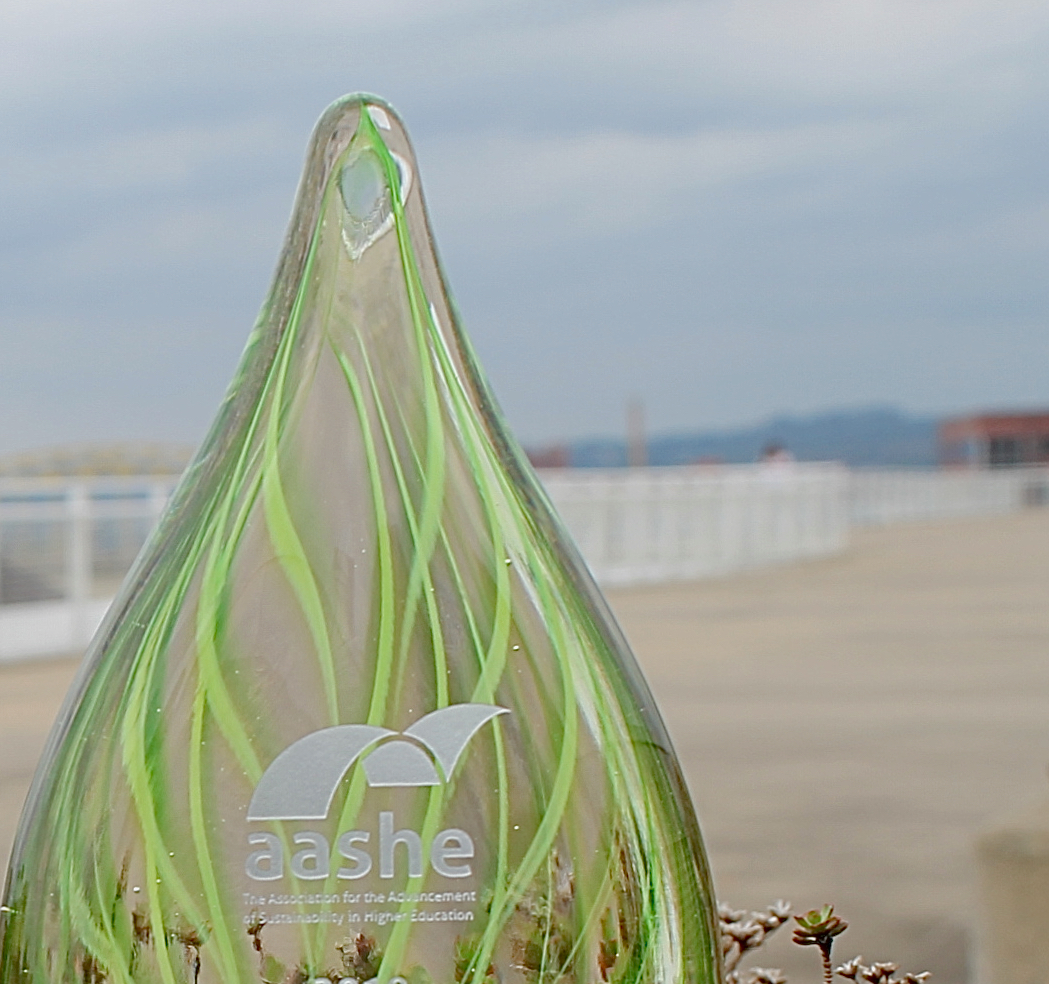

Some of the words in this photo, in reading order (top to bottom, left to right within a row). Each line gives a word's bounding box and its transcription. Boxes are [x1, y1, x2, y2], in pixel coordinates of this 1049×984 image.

[245, 811, 474, 880] aashe
[242, 892, 266, 905] The
[268, 892, 340, 905] Association
[343, 890, 361, 903] for
[364, 891, 386, 903] the
[387, 890, 477, 902] Advancement
[242, 911, 256, 924] of
[258, 910, 344, 926] Sustainability
[347, 909, 361, 923] in
[364, 909, 408, 926] Higher
[410, 908, 475, 922] Education
